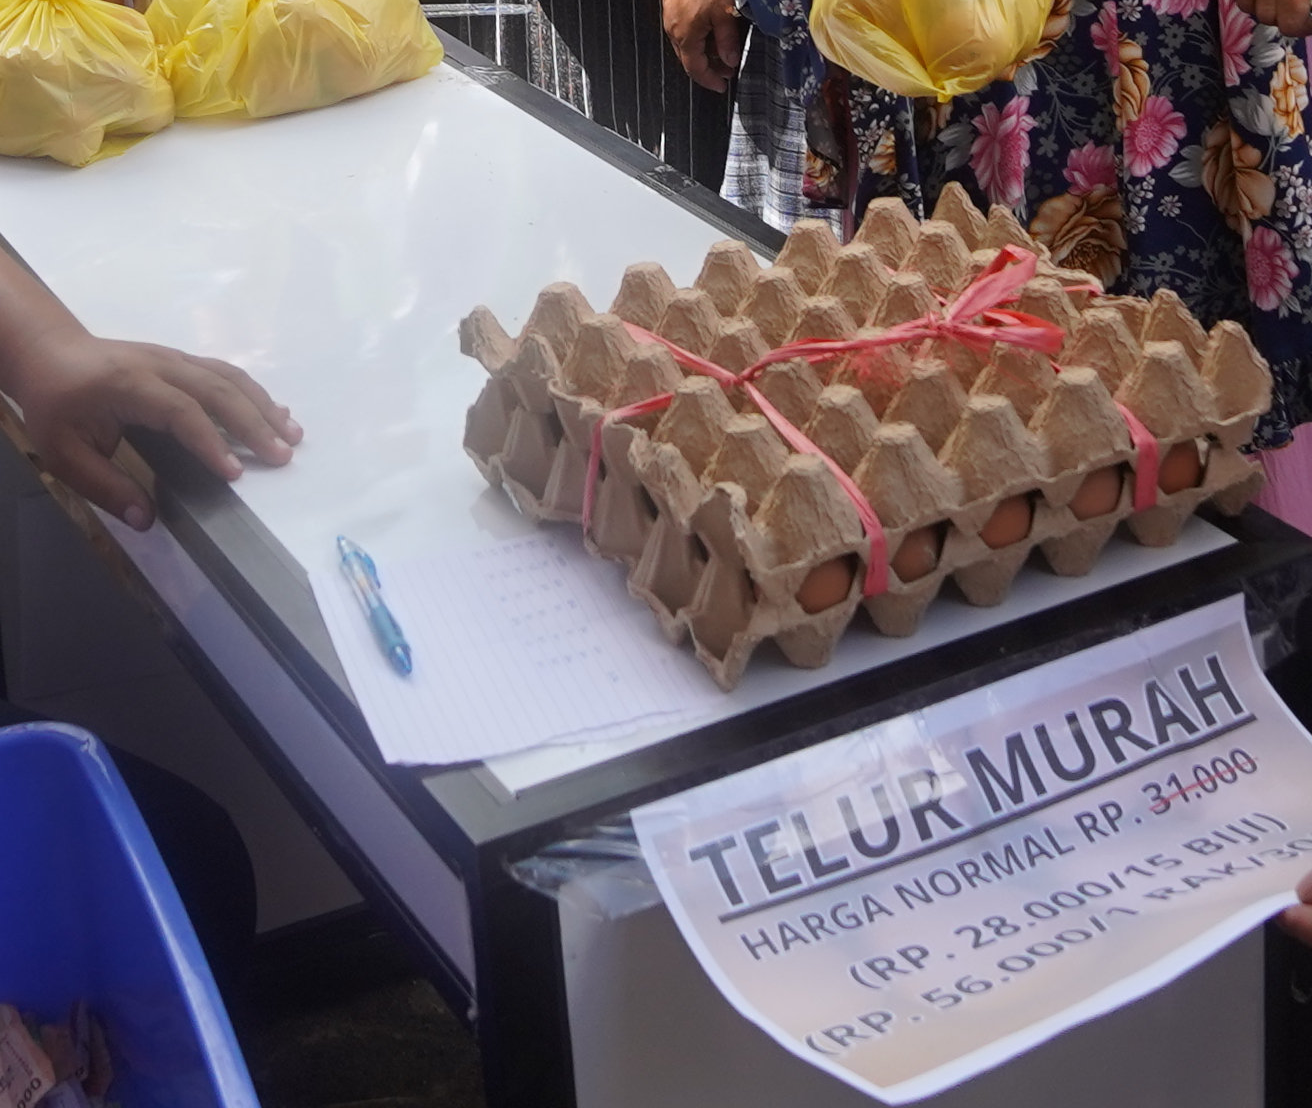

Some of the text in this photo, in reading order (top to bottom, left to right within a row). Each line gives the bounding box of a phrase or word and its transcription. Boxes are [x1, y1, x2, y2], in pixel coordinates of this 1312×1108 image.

[689, 654, 1244, 908] TELUR MURAH
[1181, 812, 1288, 856] BIJI)
[741, 894, 895, 961] HARGA
[893, 827, 1077, 910] NORMAL
